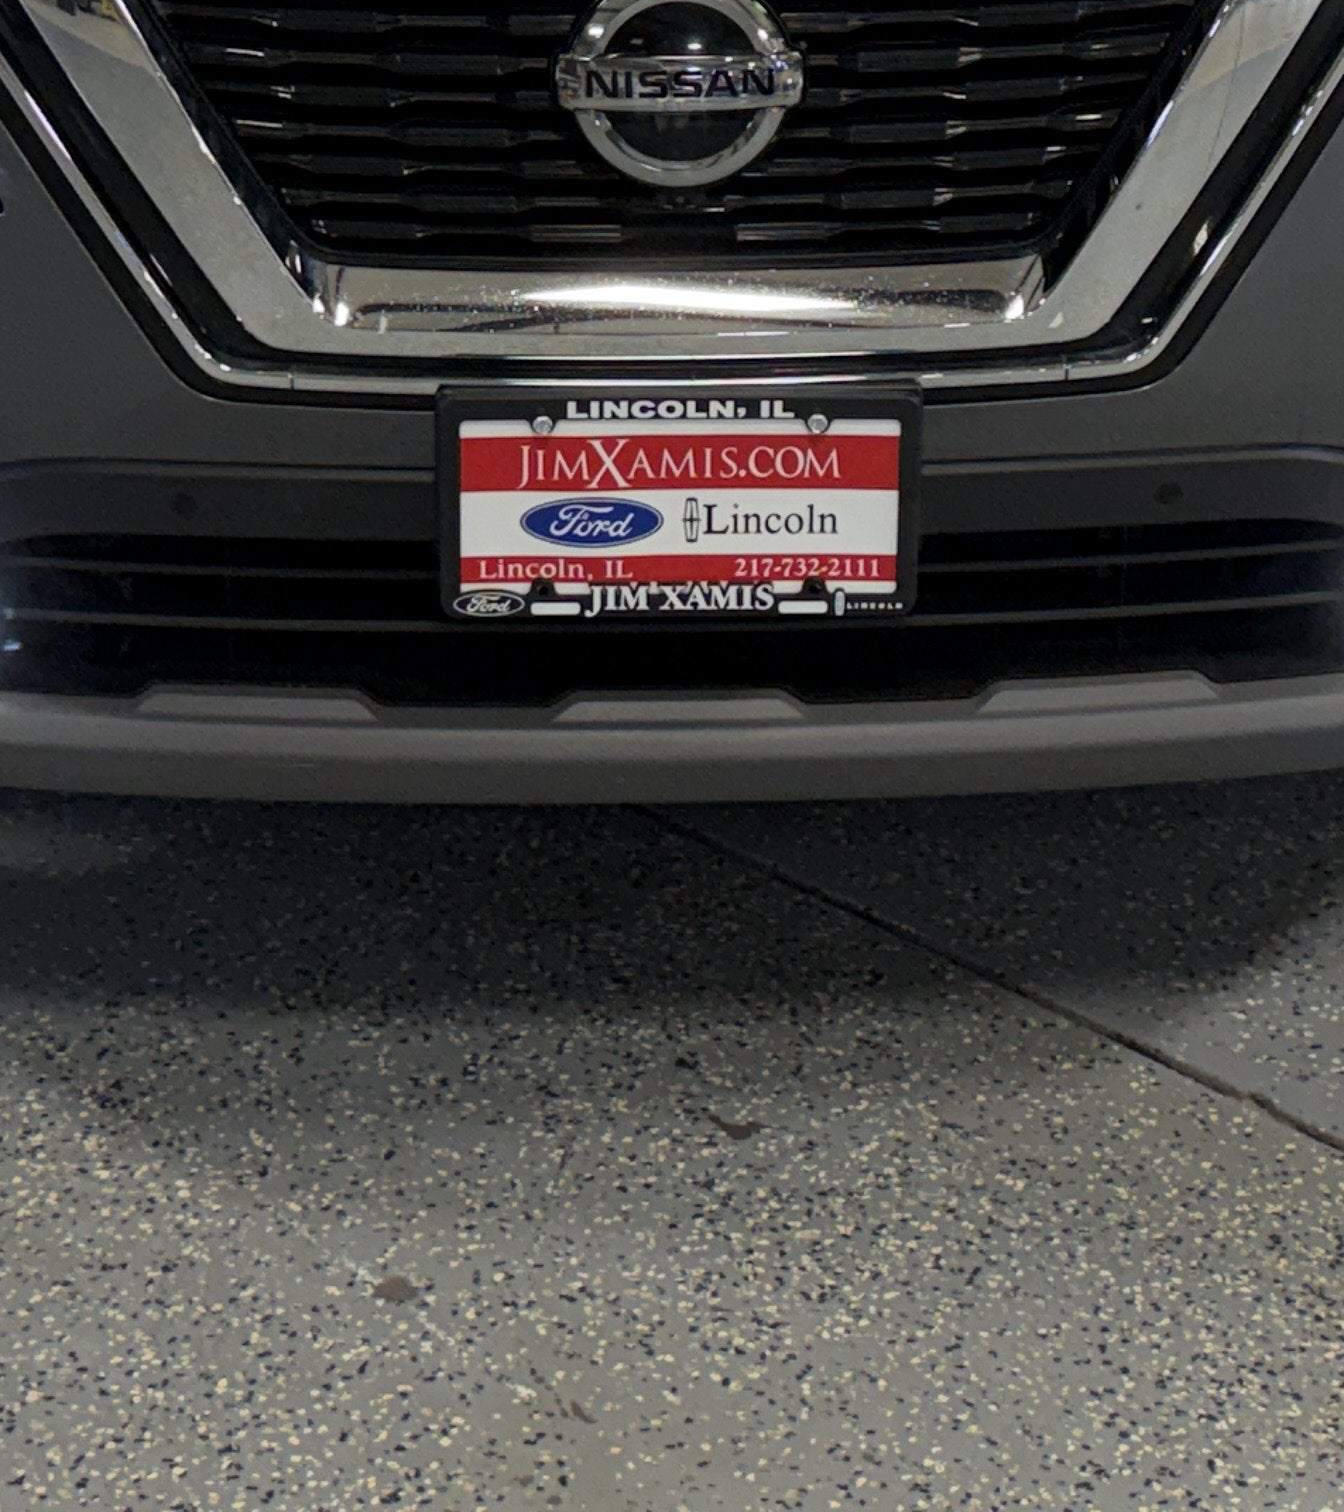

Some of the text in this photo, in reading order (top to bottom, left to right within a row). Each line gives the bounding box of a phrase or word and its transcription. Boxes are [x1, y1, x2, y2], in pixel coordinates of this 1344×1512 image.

[585, 68, 775, 98] NISSAN
[566, 400, 795, 419] LINCOLN, IL
[517, 439, 842, 488] JIMXAMIS.COM
[549, 504, 635, 537] Ford
[703, 503, 838, 535] Lincoln
[605, 560, 633, 578] IL
[734, 558, 881, 577] 217-732-2111
[466, 593, 512, 613] Ford
[584, 584, 775, 618] JIM XAMIS
